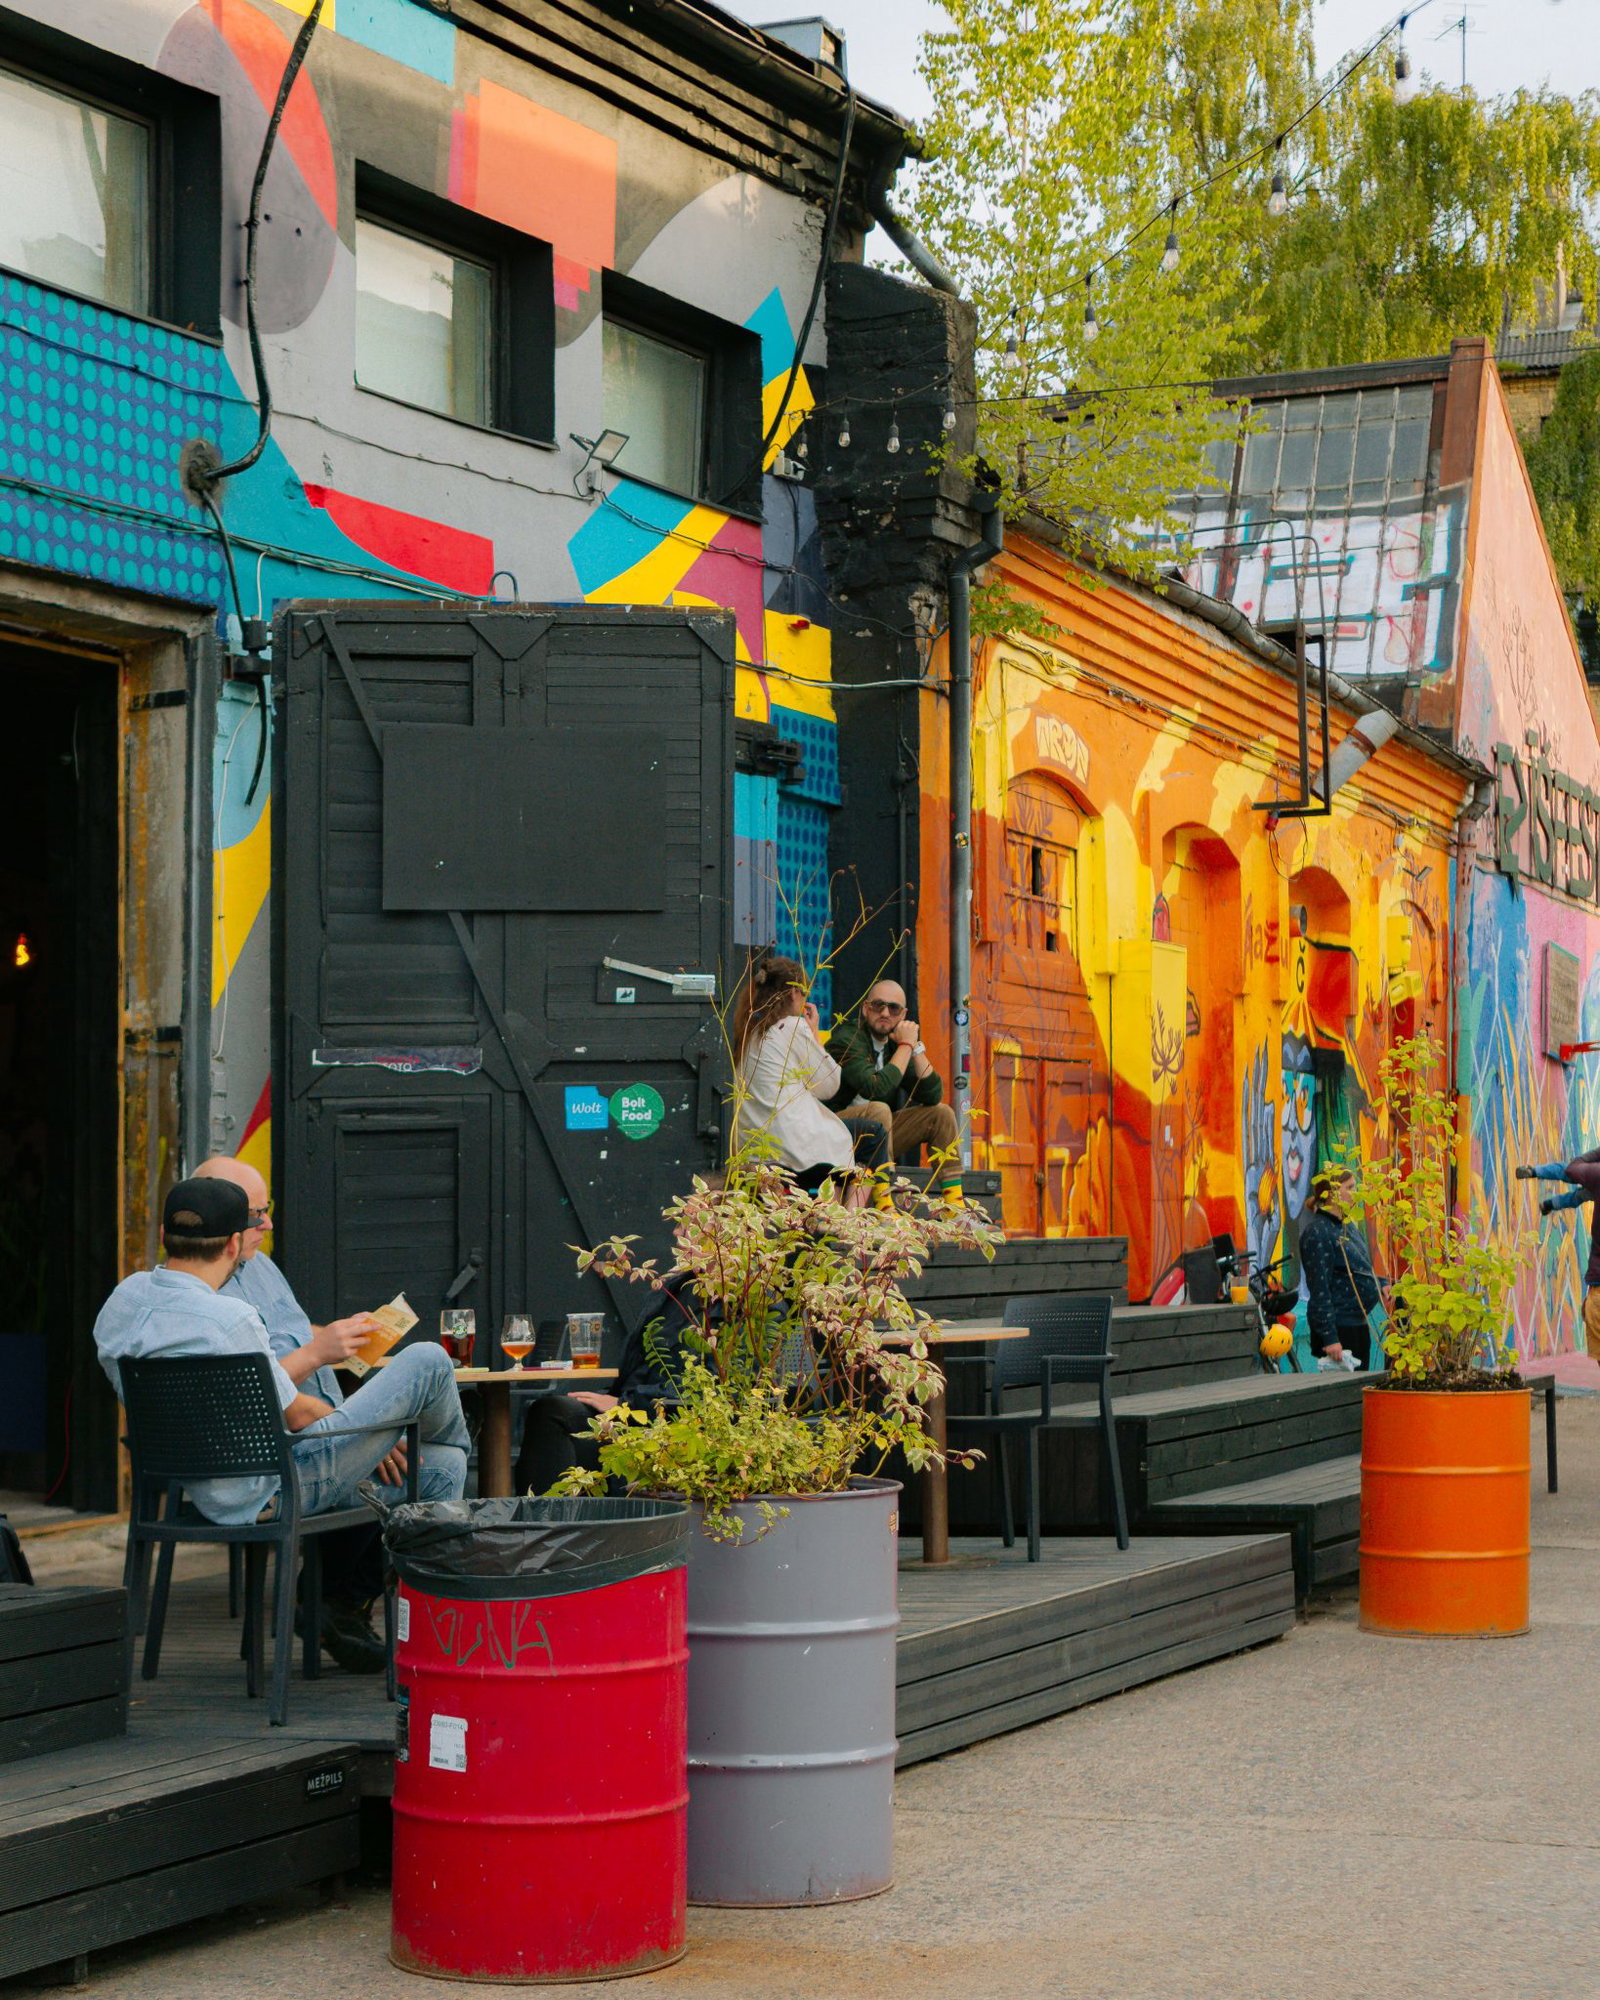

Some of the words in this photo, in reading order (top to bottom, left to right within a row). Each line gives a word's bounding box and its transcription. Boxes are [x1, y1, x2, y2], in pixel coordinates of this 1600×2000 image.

[572, 1102, 602, 1114] Wolt
[621, 1097, 646, 1110] Bolt
[621, 1109, 652, 1121] Food
[307, 1770, 344, 1791] MEŽPILS
